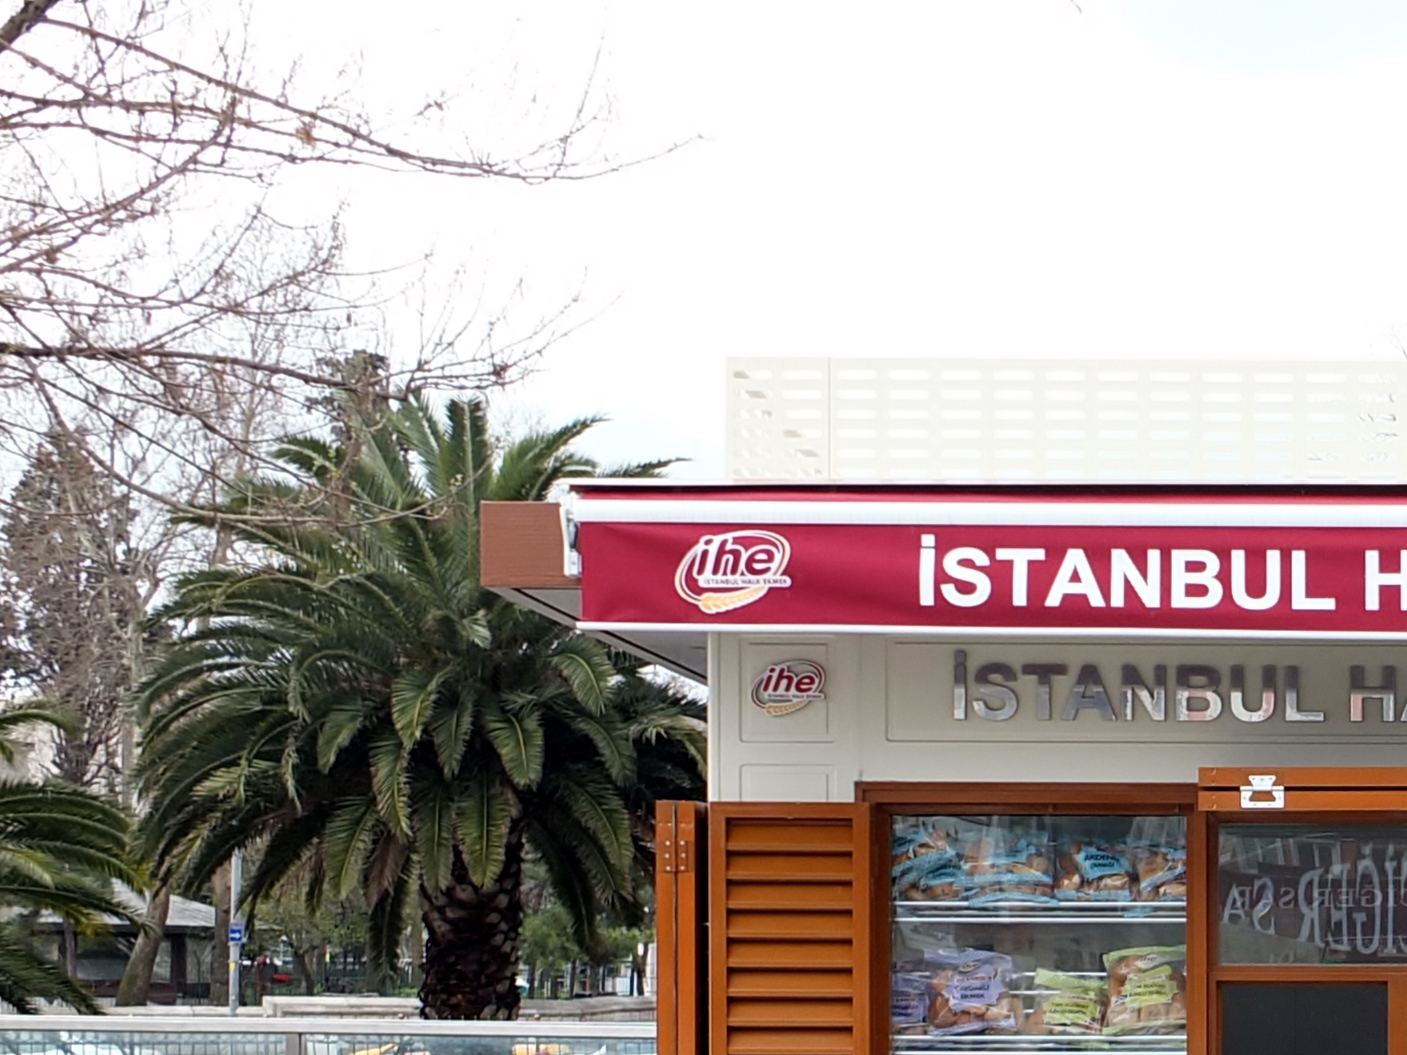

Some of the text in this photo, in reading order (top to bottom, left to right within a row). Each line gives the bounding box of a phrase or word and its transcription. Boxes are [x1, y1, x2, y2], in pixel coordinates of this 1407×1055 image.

[697, 538, 776, 576] ihe
[919, 533, 1336, 611] İSTANBUL
[762, 667, 816, 693] ihe
[953, 649, 1325, 722] İSTANBUL
